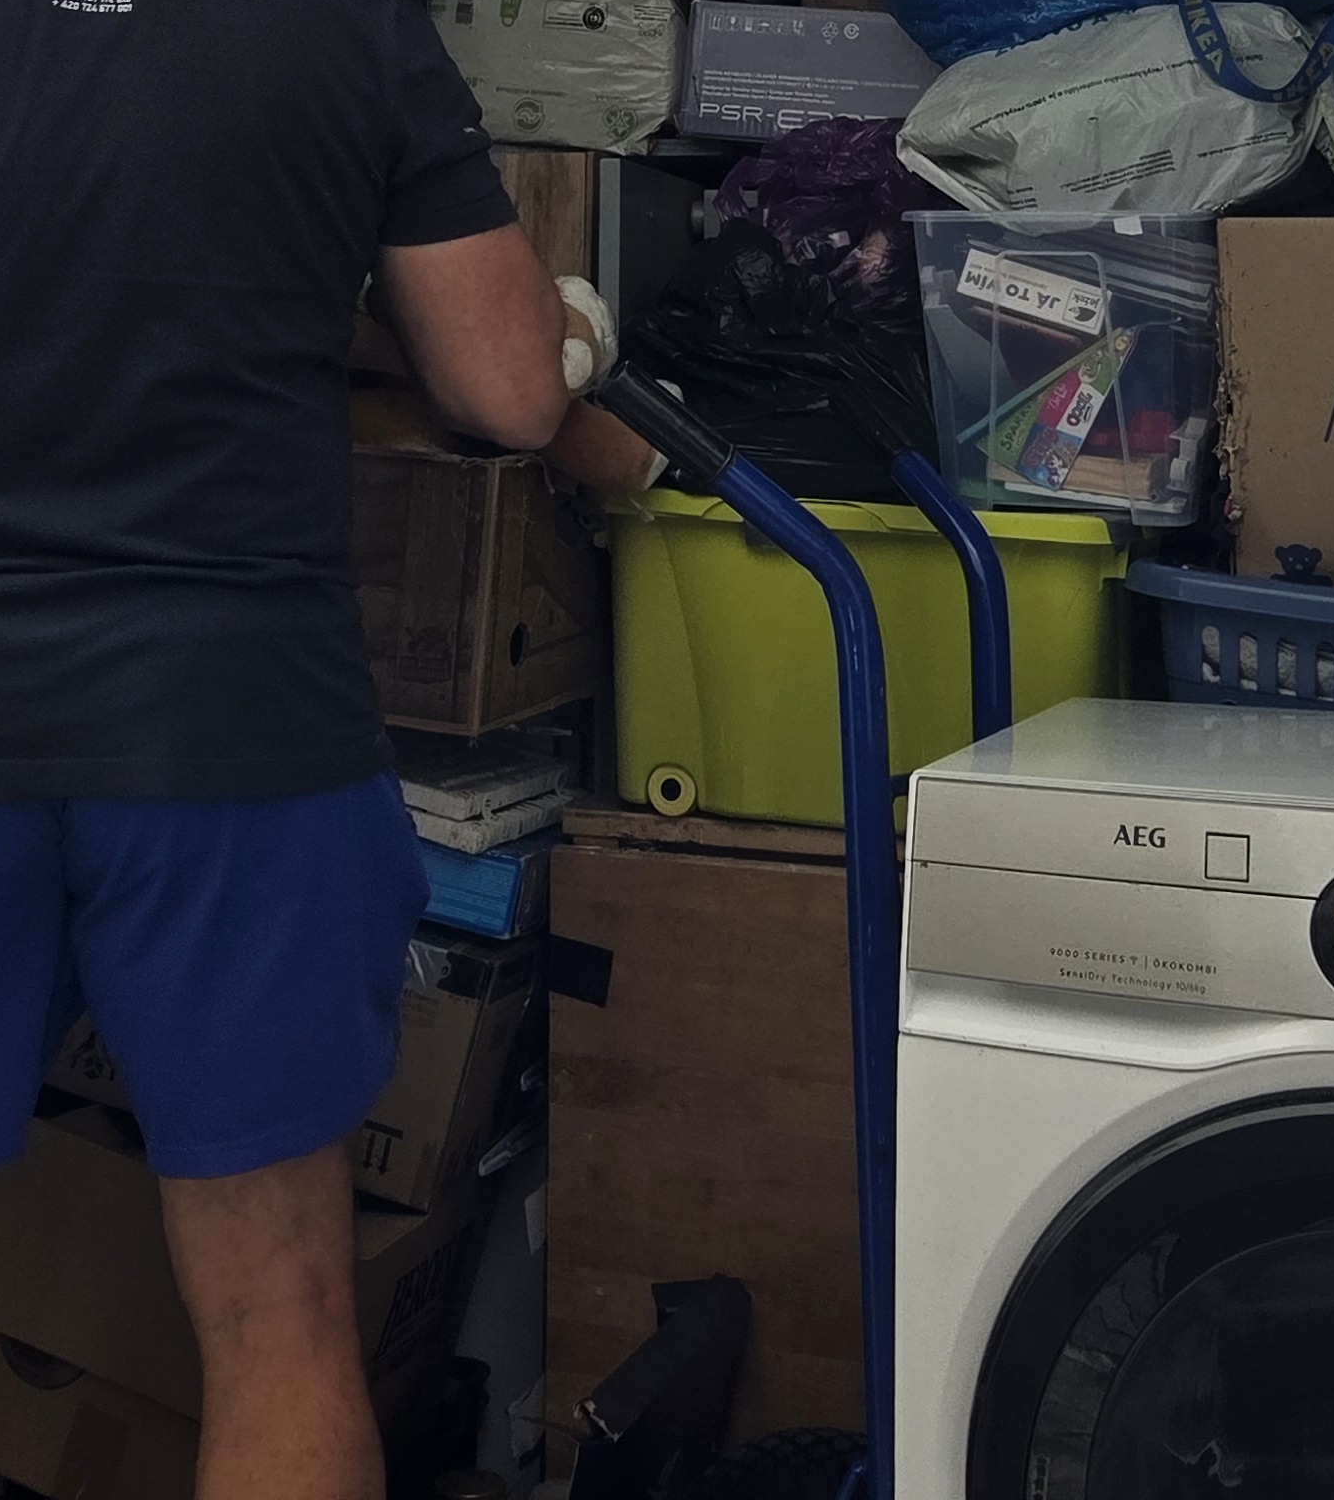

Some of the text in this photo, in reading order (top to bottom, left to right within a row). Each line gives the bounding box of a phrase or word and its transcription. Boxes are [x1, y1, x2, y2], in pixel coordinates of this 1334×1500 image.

[60, 0, 80, 10] 420
[699, 102, 889, 130] PSR-E
[1005, 283, 1030, 302] TO
[1036, 291, 1062, 310] JÁ
[1073, 293, 1101, 309] ježek
[1113, 824, 1166, 849] AEG
[1049, 947, 1079, 959] 9000
[1084, 951, 1126, 964] SERIES
[1059, 967, 1107, 984] SensiDry
[1111, 973, 1171, 992] Technology
